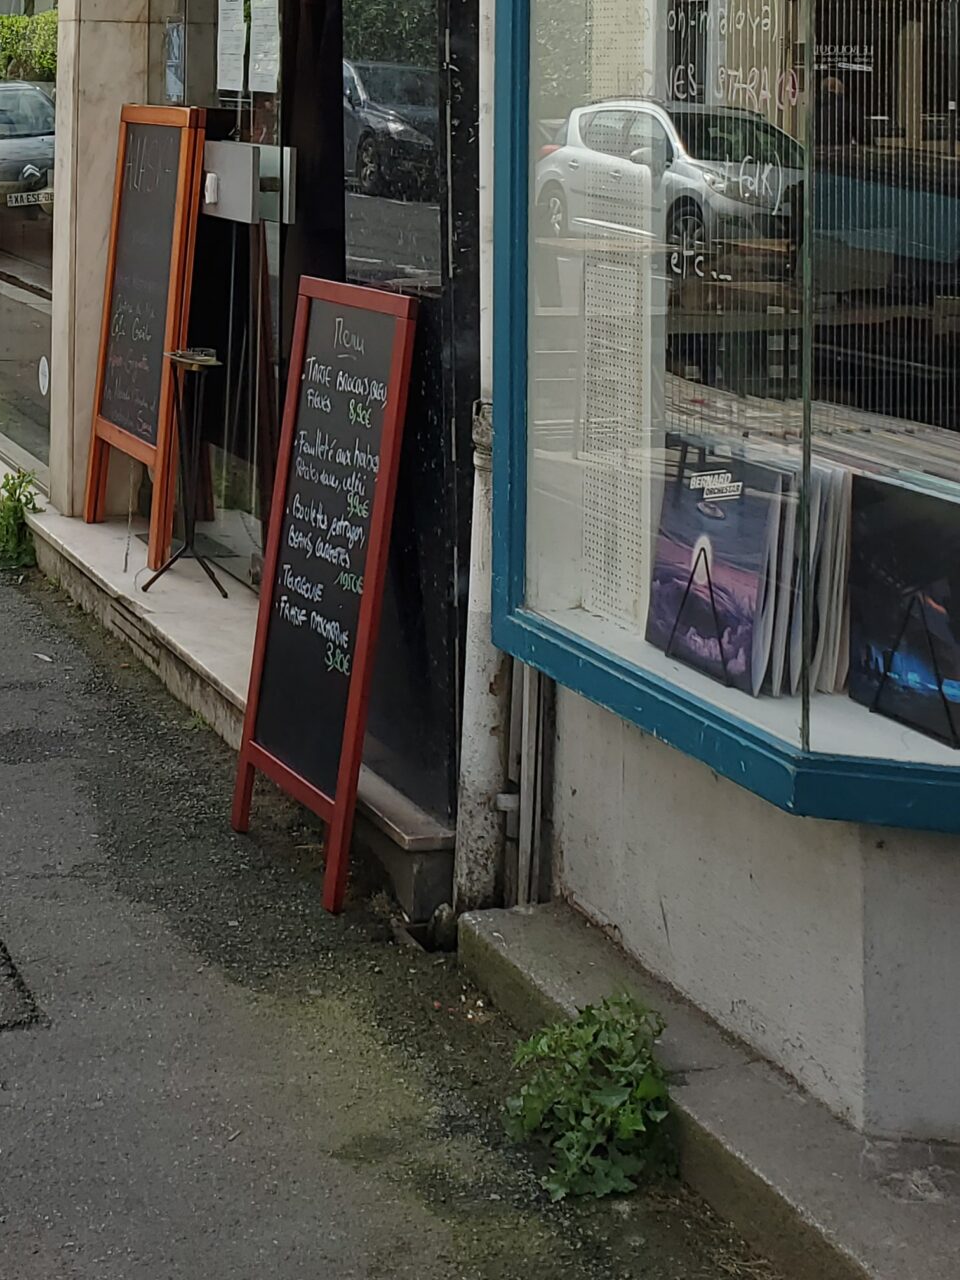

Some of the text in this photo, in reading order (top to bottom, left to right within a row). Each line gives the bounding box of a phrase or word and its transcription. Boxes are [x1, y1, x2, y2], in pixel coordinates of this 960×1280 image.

[334, 318, 365, 355] Menu
[306, 357, 332, 387] TARTE
[336, 448, 352, 466] aux
[690, 473, 732, 489] BERNARD
[324, 641, 351, 676] 3,80€
